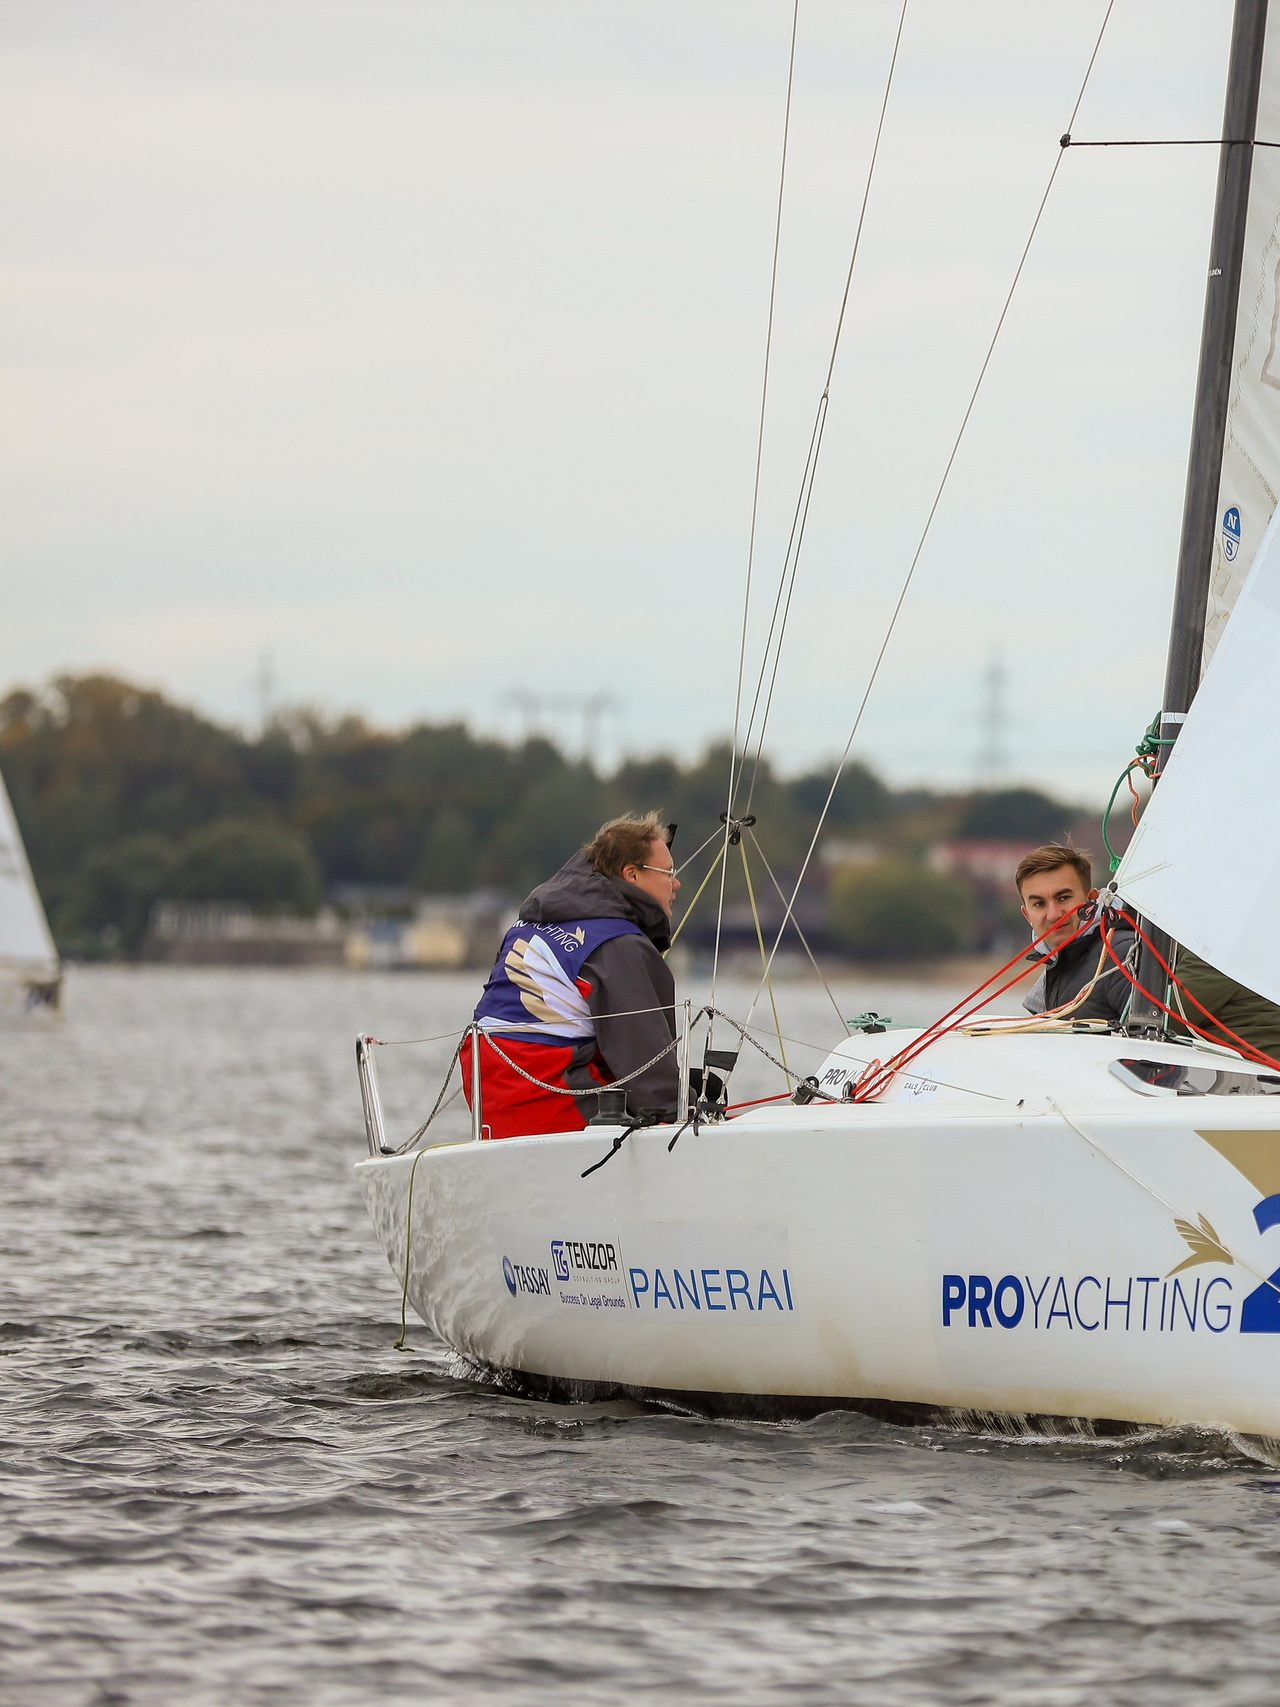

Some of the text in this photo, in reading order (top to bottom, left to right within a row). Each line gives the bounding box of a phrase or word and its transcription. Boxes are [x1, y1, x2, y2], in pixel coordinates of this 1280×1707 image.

[565, 1241, 618, 1271] TENZOR
[513, 1264, 552, 1296] TASSAY
[628, 1268, 795, 1311] PANERAI
[559, 1291, 580, 1305] Success
[587, 1293, 602, 1309] Legal
[602, 1294, 626, 1308] Grounds
[942, 1274, 1233, 1333] PROYACHTING
